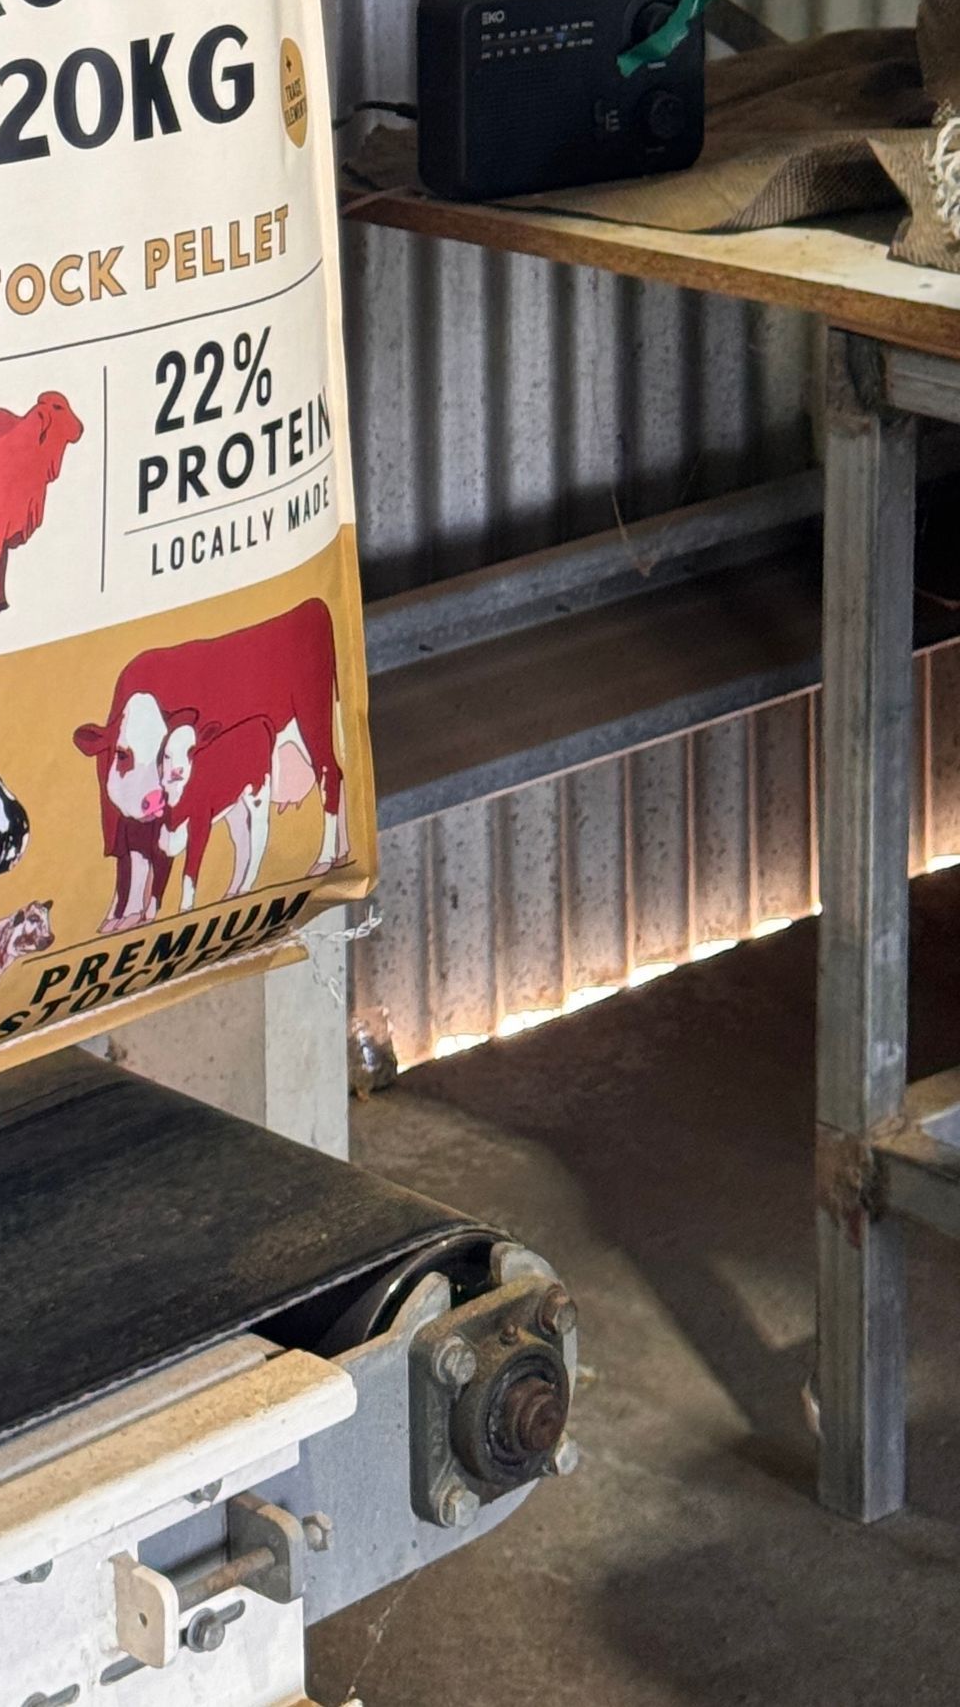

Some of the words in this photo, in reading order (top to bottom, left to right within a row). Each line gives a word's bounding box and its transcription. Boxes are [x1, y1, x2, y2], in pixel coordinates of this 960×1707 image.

[144, 204, 289, 290] PELLET
[154, 325, 271, 436] 22%
[138, 386, 331, 514] PROTEIN
[151, 507, 274, 575] LOCALLY
[288, 475, 329, 532] MADE
[30, 890, 312, 1006] PREMIUM
